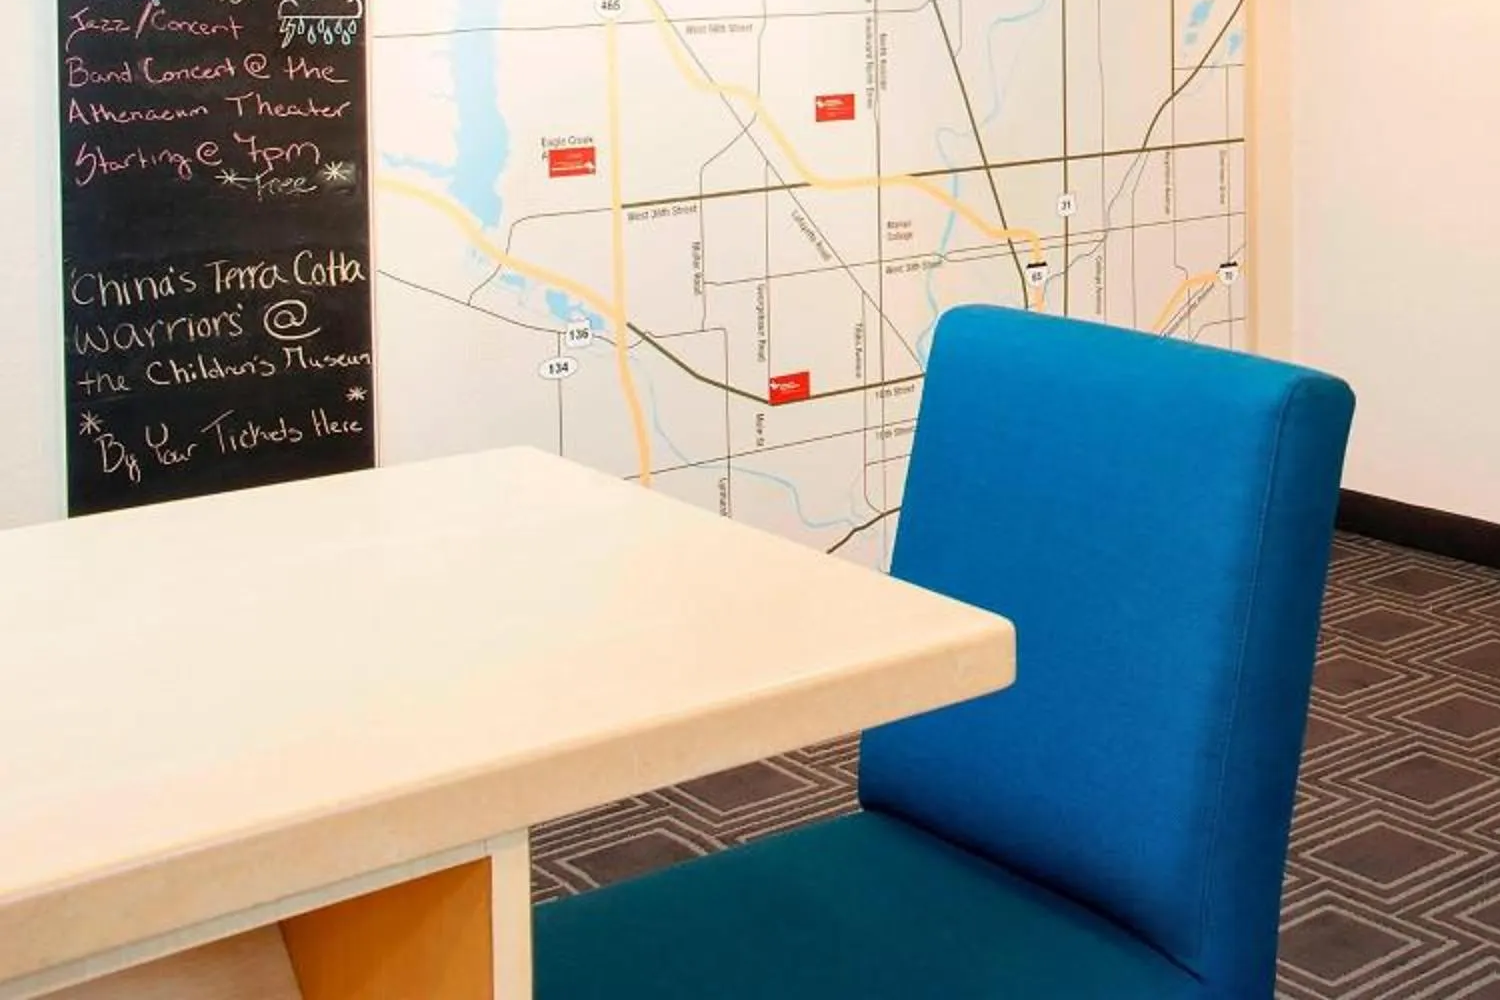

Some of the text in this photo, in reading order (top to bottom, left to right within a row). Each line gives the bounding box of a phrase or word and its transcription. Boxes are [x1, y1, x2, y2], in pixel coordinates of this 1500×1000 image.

[601, 0, 621, 11] 465
[66, 53, 349, 87] Band Concert @ the
[224, 91, 351, 117] Theater
[75, 131, 320, 187] Starting @ 7pm
[205, 259, 287, 294] Terra
[292, 249, 366, 287] Cotta
[263, 299, 321, 340] @
[78, 368, 132, 396] the
[548, 361, 569, 375] 134
[96, 432, 141, 484] By
[201, 408, 303, 454] Tickets
[311, 407, 363, 438] Here
